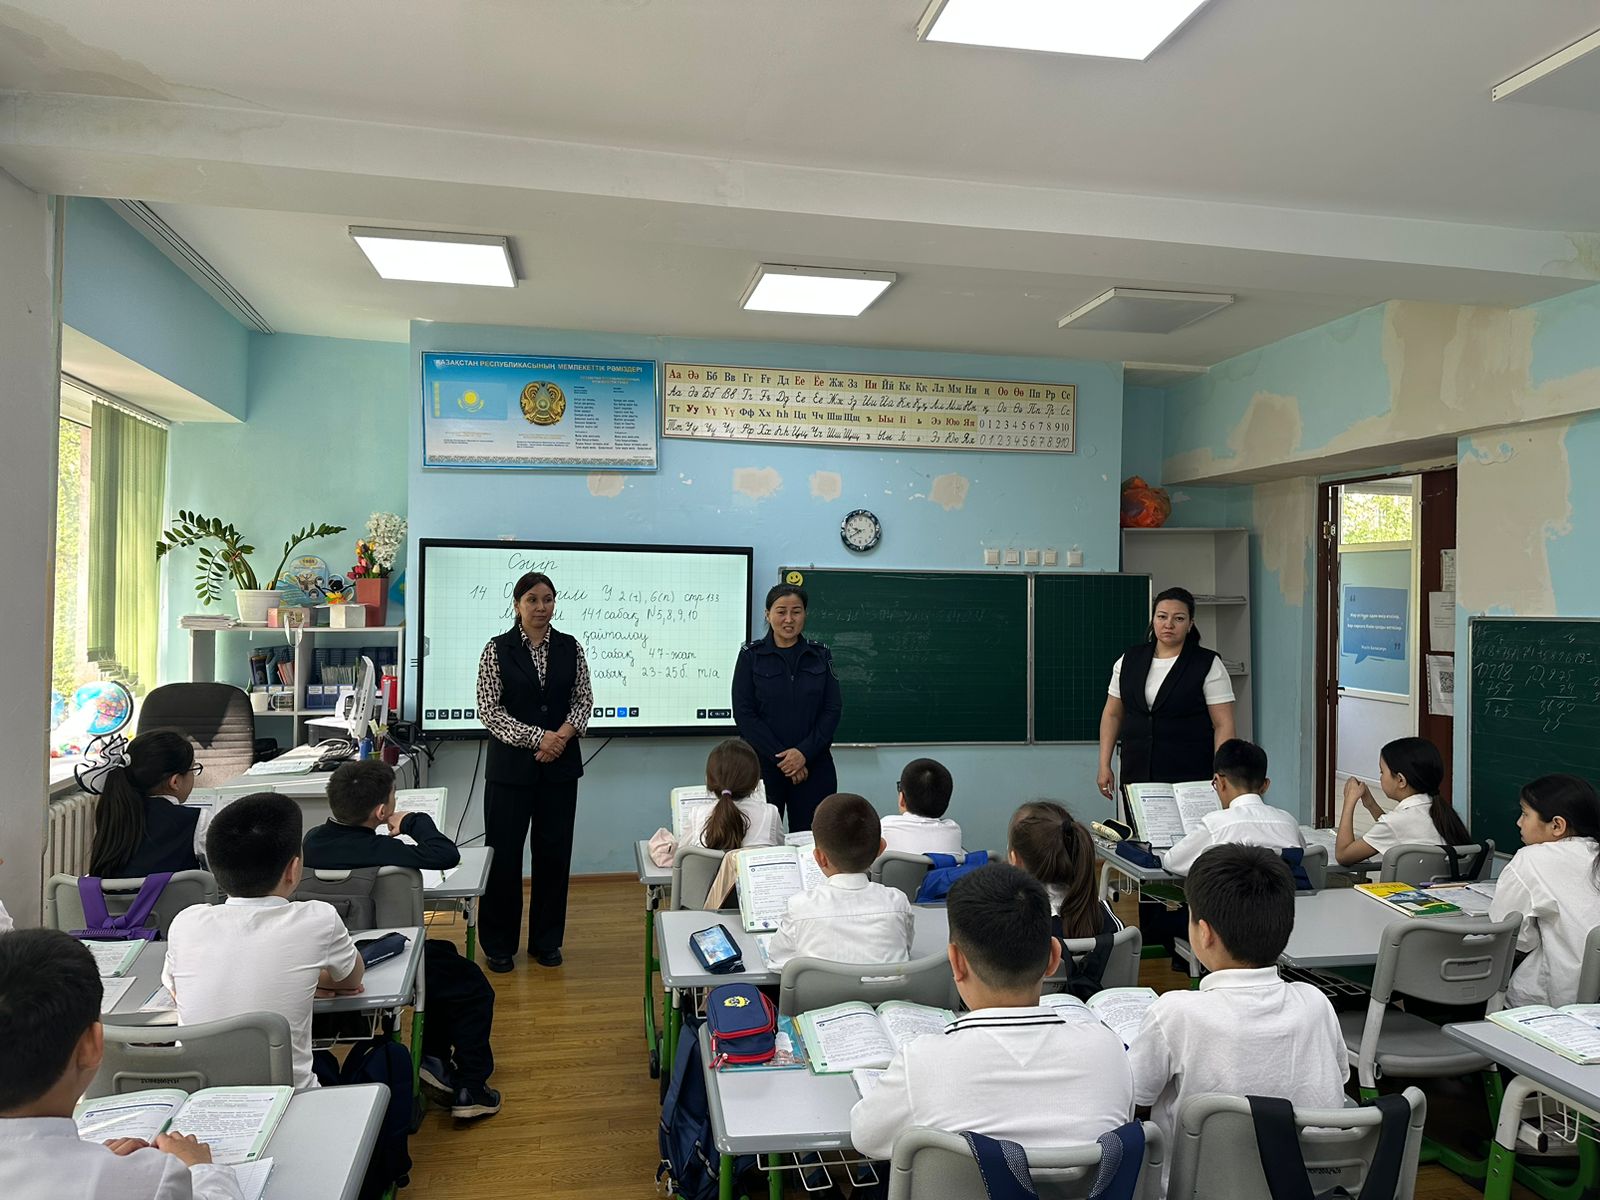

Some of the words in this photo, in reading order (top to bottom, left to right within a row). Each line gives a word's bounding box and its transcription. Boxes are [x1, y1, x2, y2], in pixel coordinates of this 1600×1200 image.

[669, 369, 682, 379] Аа
[687, 370, 699, 379] Әә
[706, 371, 718, 381] Бб
[724, 372, 736, 382] Вв
[743, 373, 753, 383] Гг
[761, 373, 771, 384] Ғғ
[777, 375, 789, 386] Дд
[795, 376, 805, 385] Ее
[814, 374, 824, 386] Ёё
[829, 377, 844, 387] Жж
[848, 378, 858, 388] Зз
[865, 380, 877, 389] Ии
[882, 379, 894, 390] Йй
[899, 381, 911, 391] Кк
[916, 382, 928, 393] Ққ
[932, 383, 944, 393] Лл
[948, 384, 961, 394] Мм
[965, 385, 976, 394] Нн
[998, 387, 1008, 395] Оо
[1014, 388, 1024, 396] Өө
[1029, 389, 1040, 398] Пп
[1046, 390, 1056, 401] Рр
[1061, 391, 1071, 400] Сс
